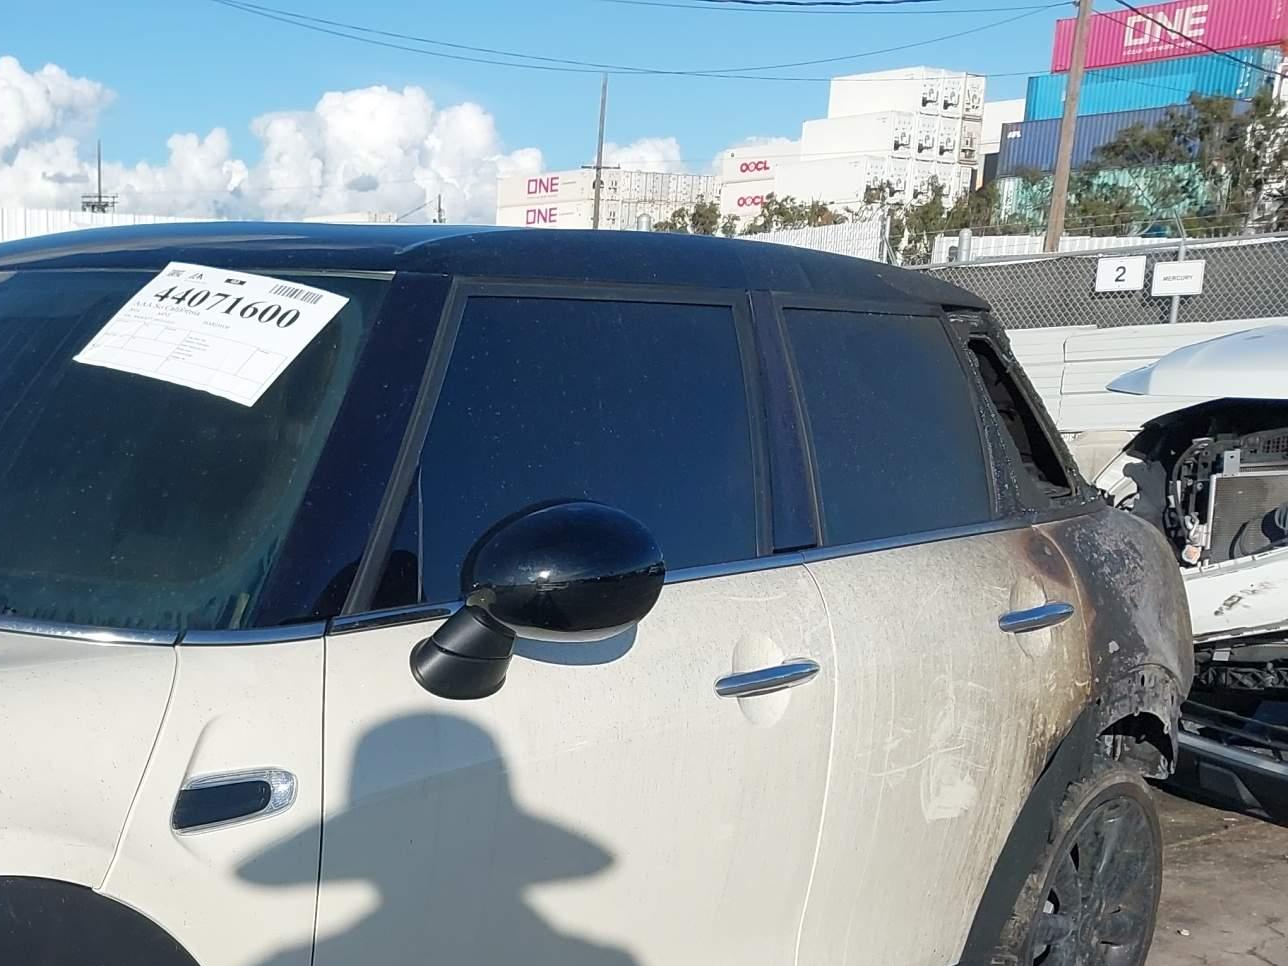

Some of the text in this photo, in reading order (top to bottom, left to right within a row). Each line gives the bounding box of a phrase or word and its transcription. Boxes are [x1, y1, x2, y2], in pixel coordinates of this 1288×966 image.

[1124, 4, 1209, 47] ONE
[740, 161, 770, 173] OOCL
[527, 177, 559, 194] ONE
[737, 195, 768, 208] OOCL
[526, 208, 558, 225] ONE
[1114, 266, 1127, 282] 2
[154, 286, 300, 328] 44071600
